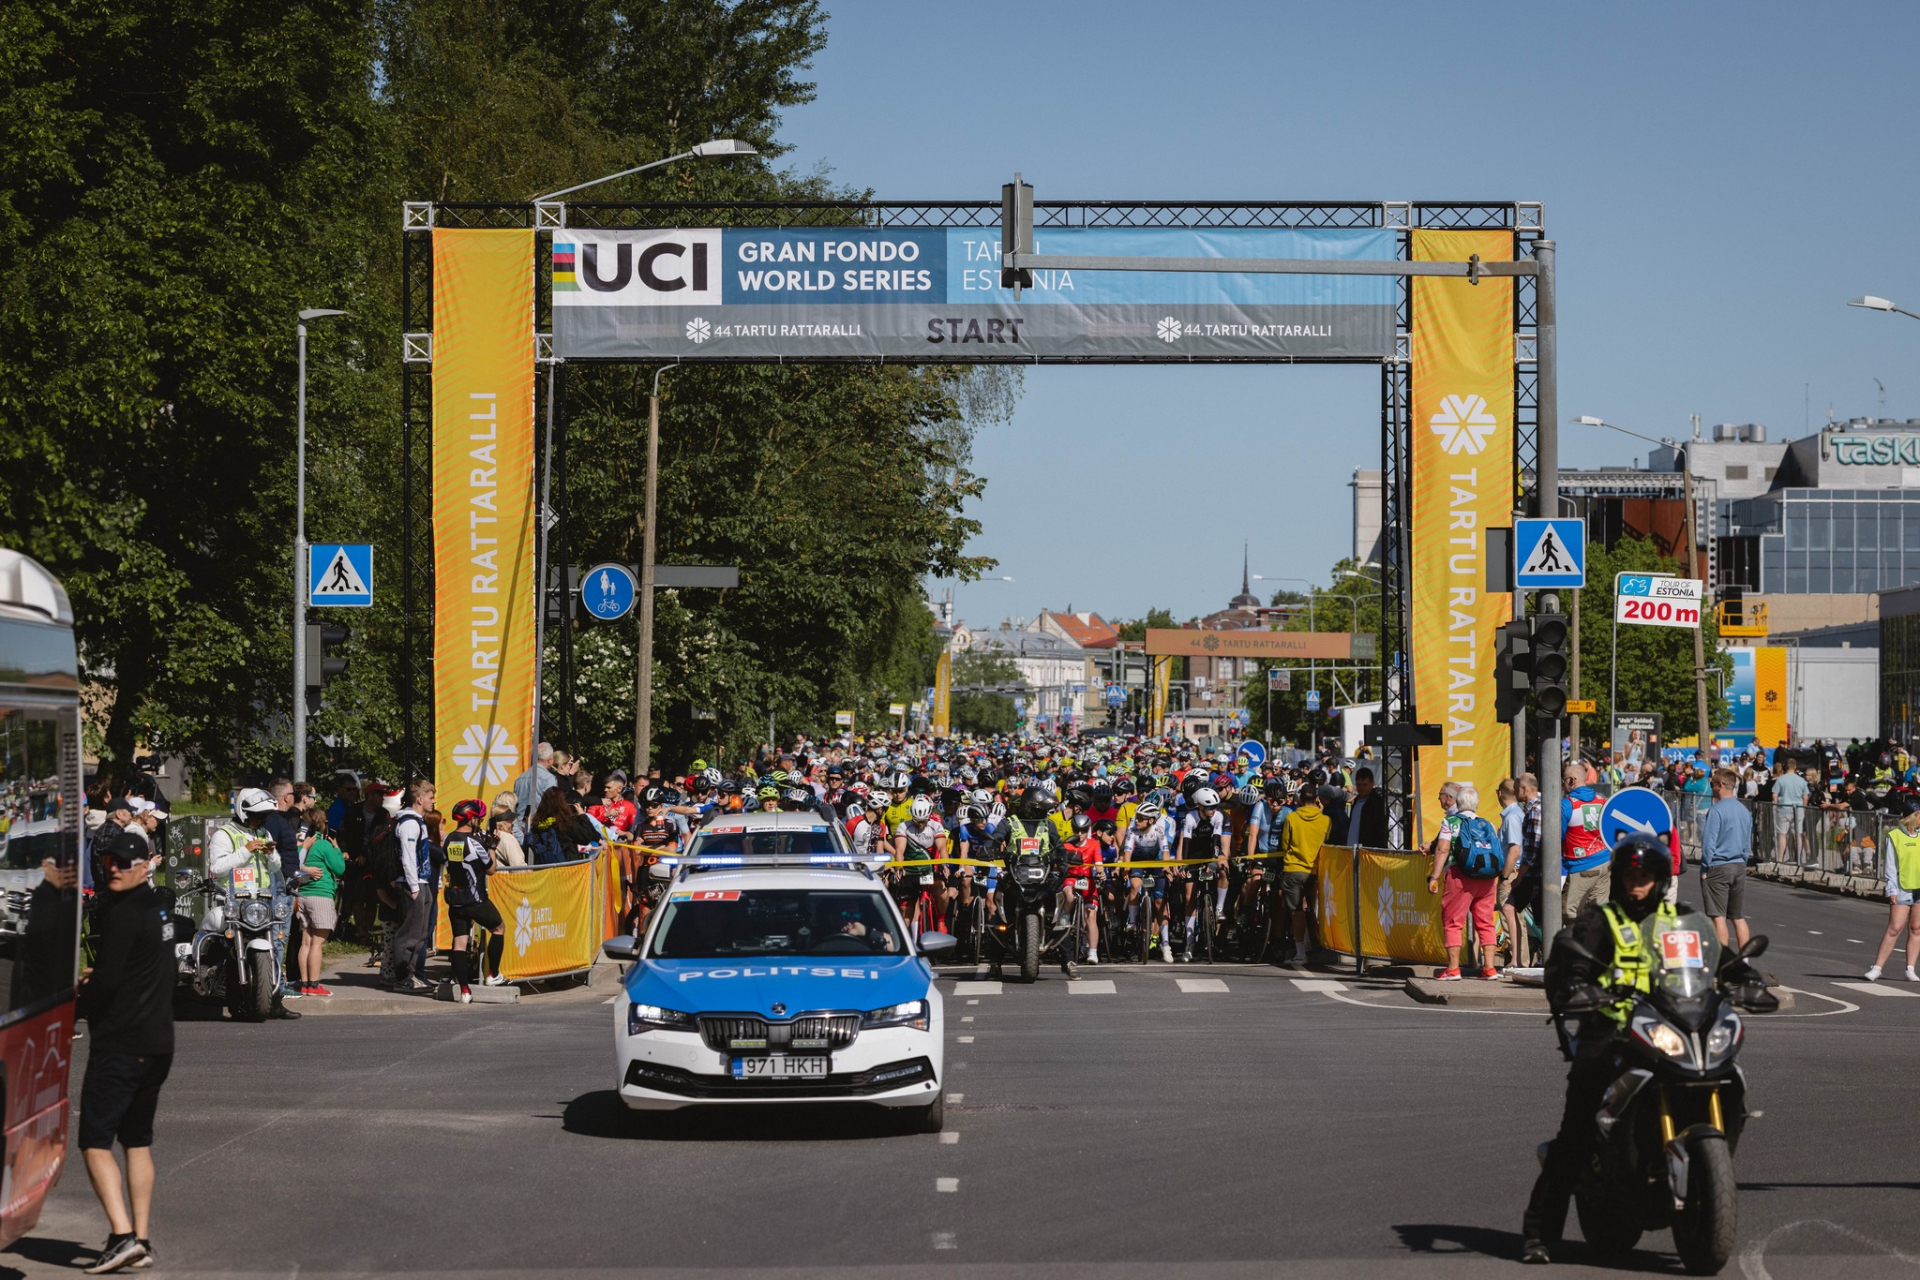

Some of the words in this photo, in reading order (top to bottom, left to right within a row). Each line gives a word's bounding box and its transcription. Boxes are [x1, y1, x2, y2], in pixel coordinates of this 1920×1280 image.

[738, 241, 816, 263] GRAN
[823, 241, 920, 262] FONDO
[963, 241, 1040, 261] TAR
[582, 242, 708, 292] UCI
[738, 269, 836, 291] WORLD
[842, 269, 932, 291] SERIES
[963, 269, 1075, 291] ESTNIA
[781, 324, 861, 337] RATTARALLI
[927, 318, 1024, 344] START
[1252, 324, 1332, 337] RATTARALLI
[469, 392, 499, 595] RATTARALLI
[1449, 467, 1478, 575] TARTU
[1656, 587, 1695, 597] ESTONIA
[1660, 580, 1680, 588] TOUR
[1624, 600, 1672, 621] 200
[1675, 607, 1698, 623] m
[1190, 639, 1200, 648] 44
[1222, 639, 1251, 649] TARTU
[1253, 640, 1307, 650] RATTARALLI
[471, 605, 500, 711] TARTU
[703, 891, 723, 899] P1
[1396, 892, 1415, 907] TARTU
[533, 907, 553, 923] TARTU
[533, 922, 567, 942] RATTARALLI
[678, 967, 879, 982] POLITSEI
[747, 1058, 776, 1074] 971
[784, 1058, 823, 1074] HKH
